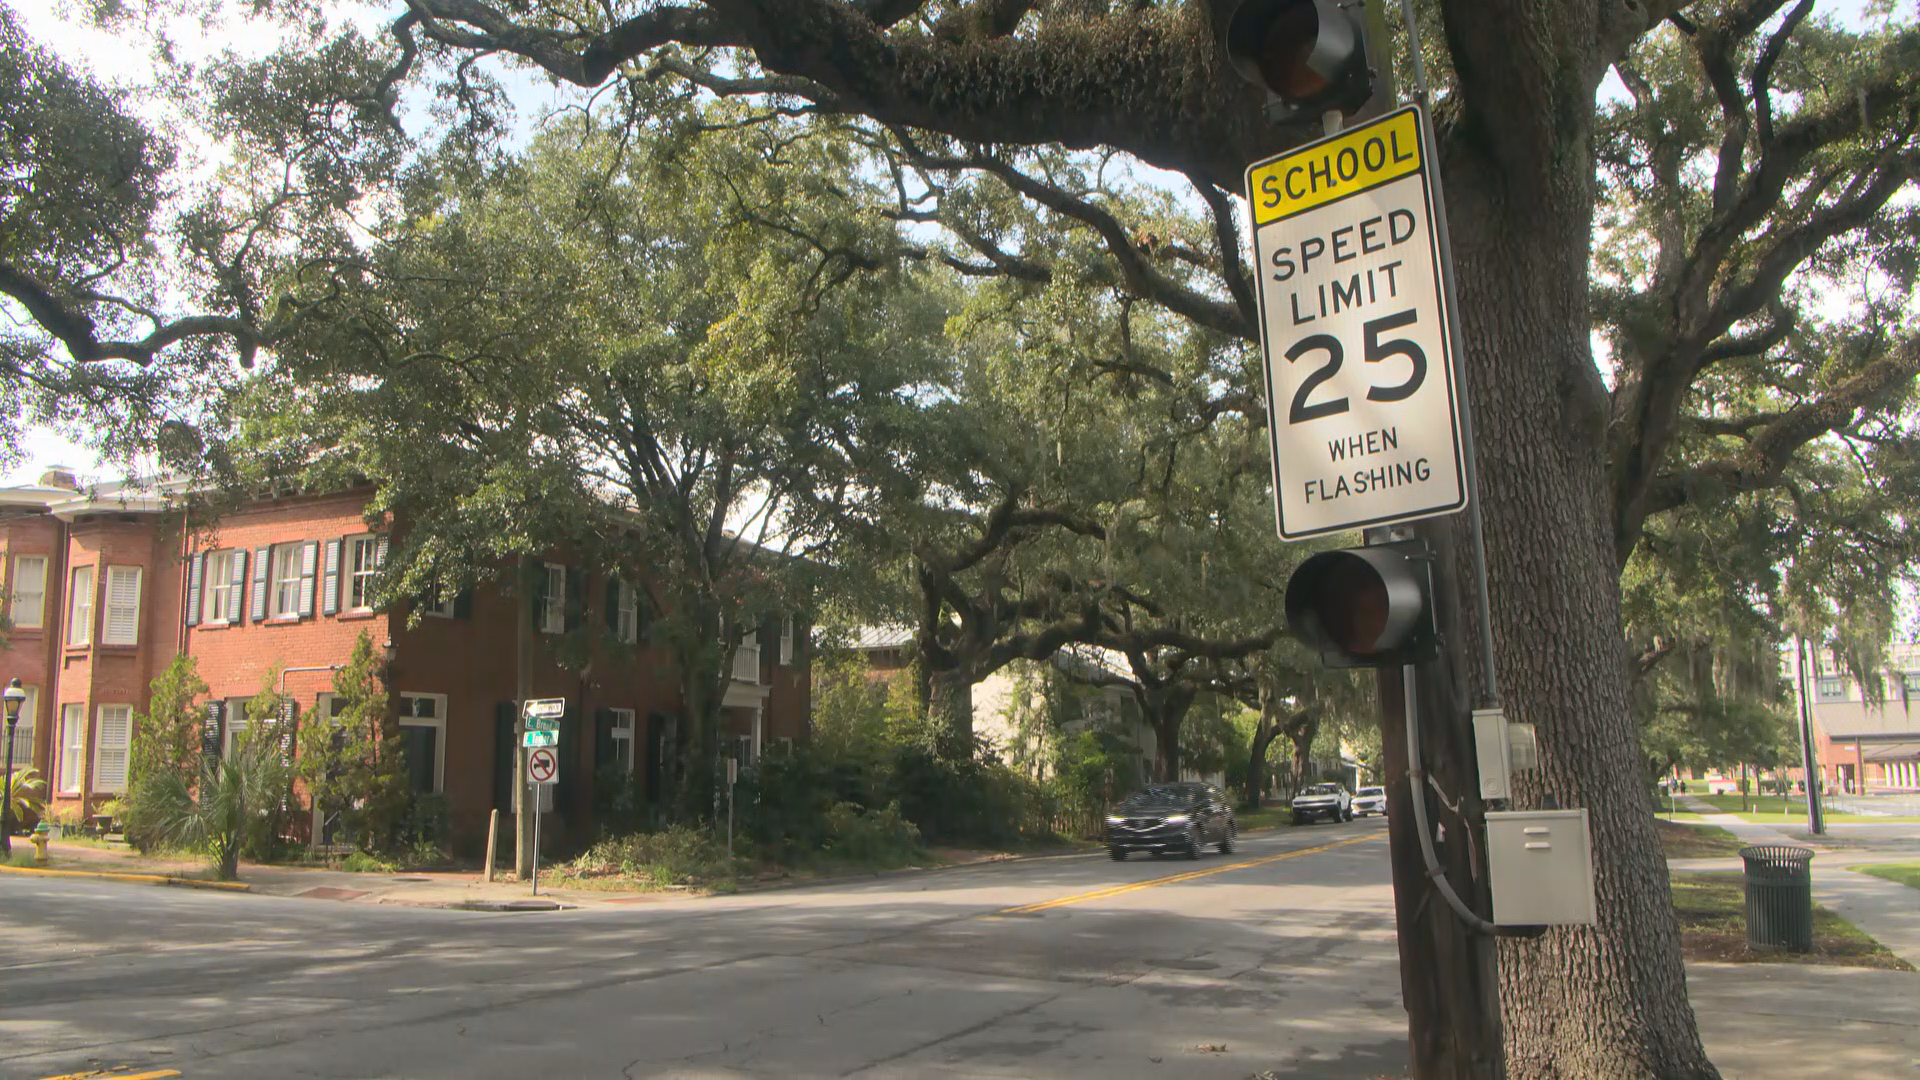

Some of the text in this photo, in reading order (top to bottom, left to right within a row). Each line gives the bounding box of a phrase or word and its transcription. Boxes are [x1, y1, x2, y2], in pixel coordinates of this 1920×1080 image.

[1261, 130, 1413, 208] SCHOOL
[1272, 208, 1416, 281] SPEED
[1291, 260, 1402, 326] LIMIT
[1284, 308, 1427, 425] 25
[1328, 427, 1398, 462] WHEN
[1305, 458, 1430, 504] FLASHING
